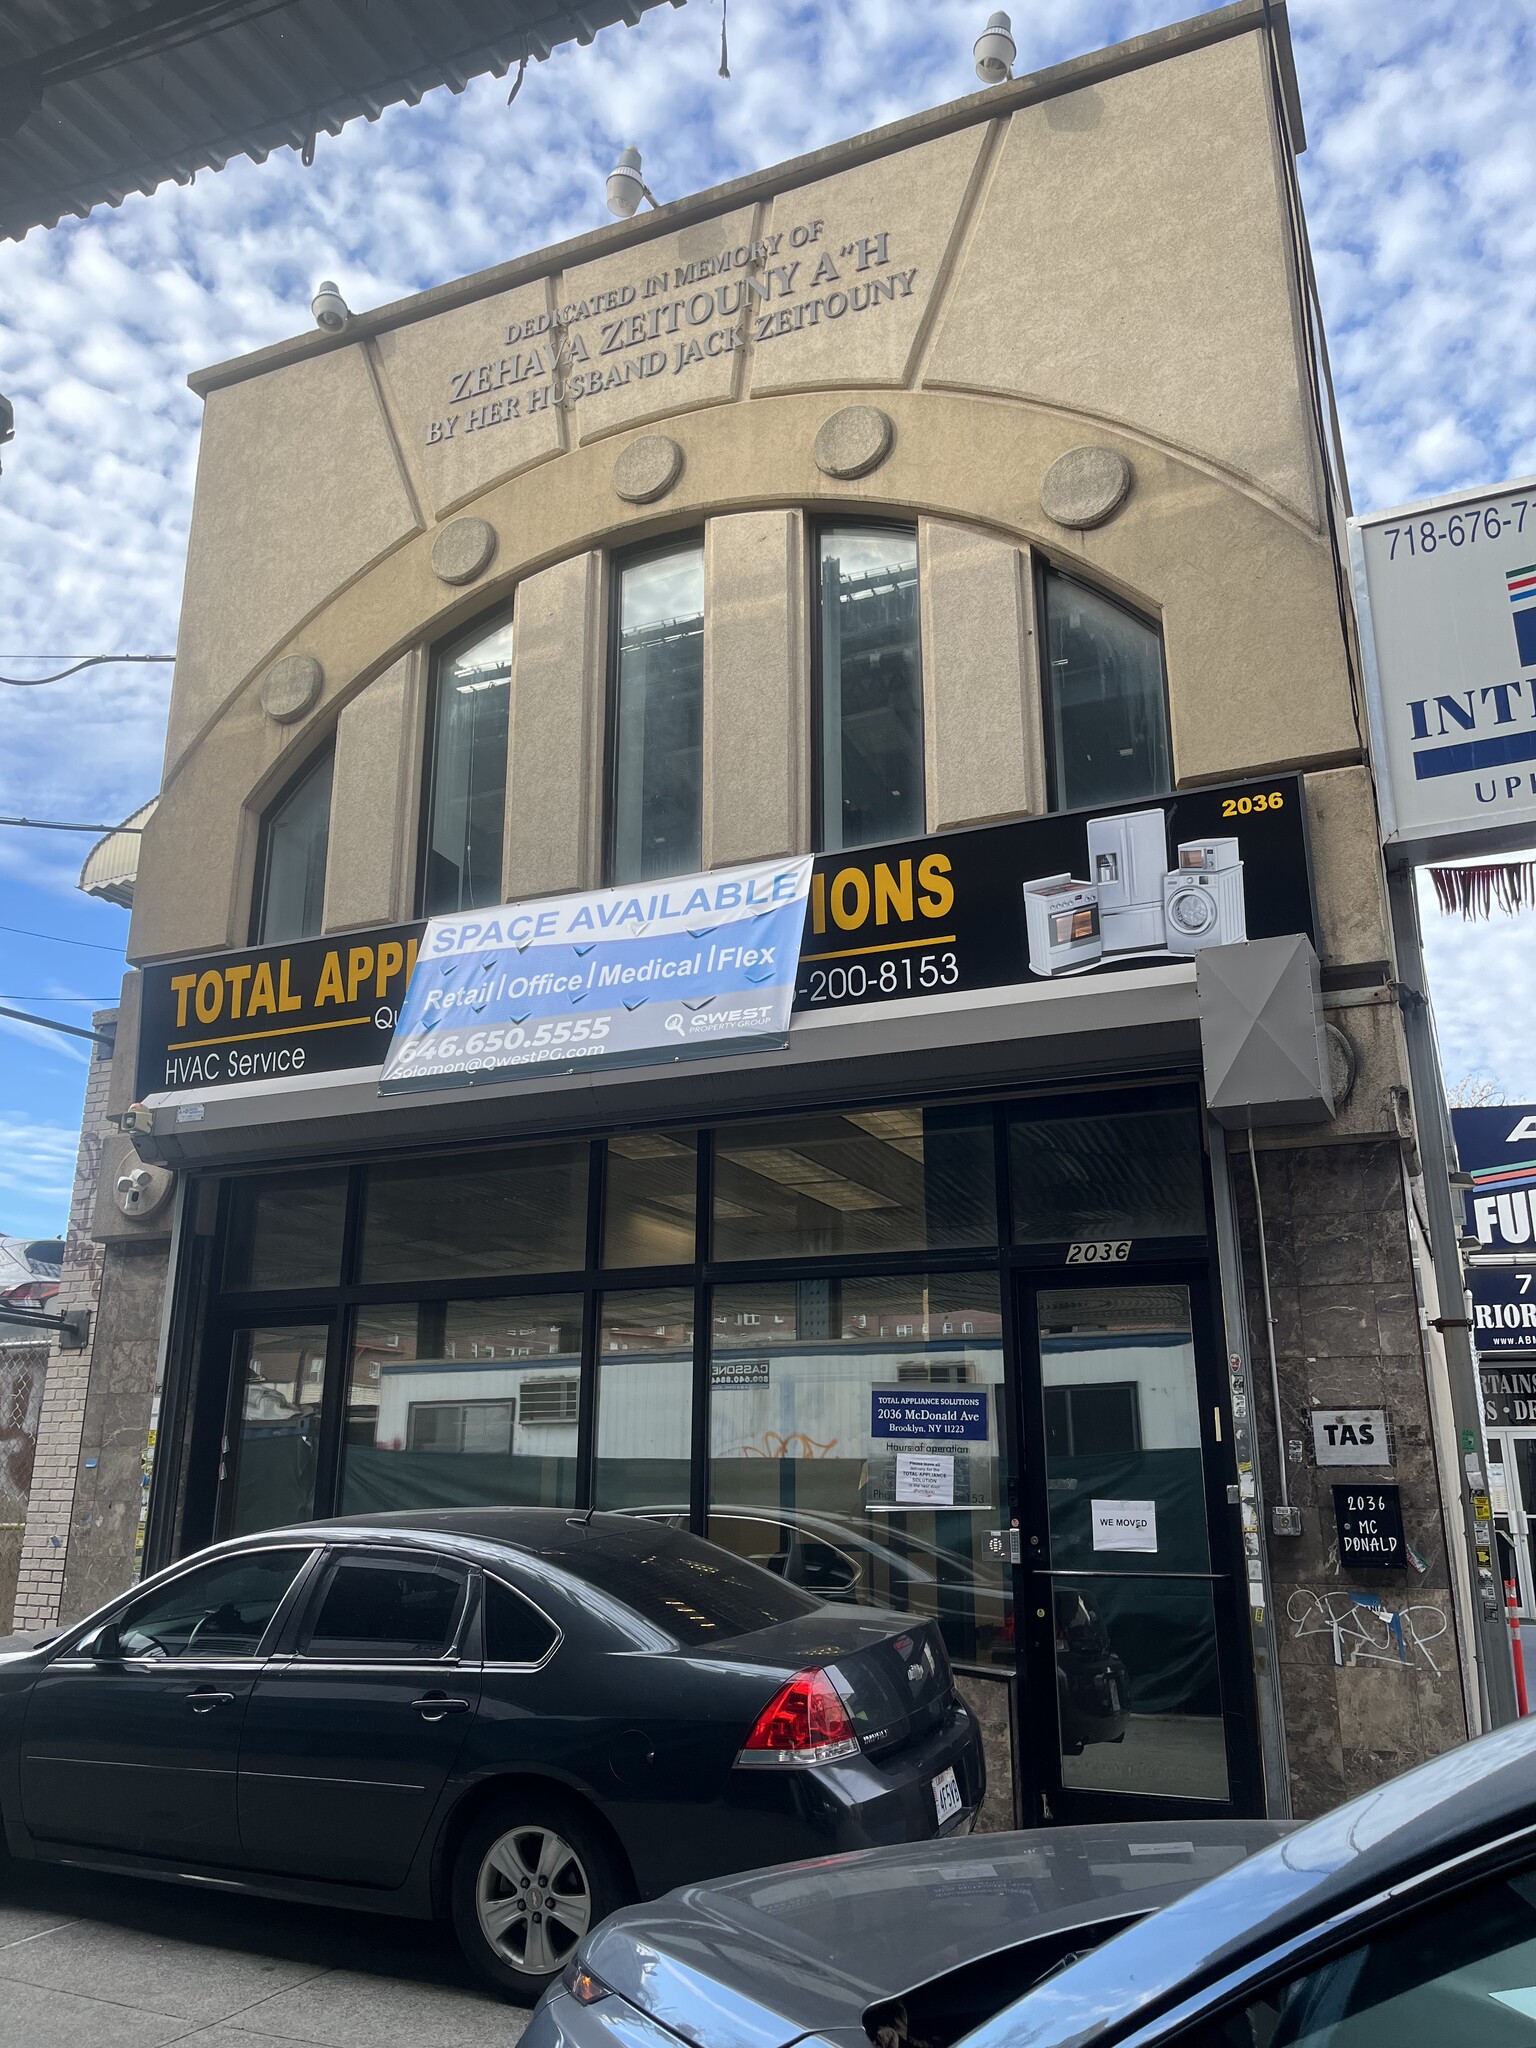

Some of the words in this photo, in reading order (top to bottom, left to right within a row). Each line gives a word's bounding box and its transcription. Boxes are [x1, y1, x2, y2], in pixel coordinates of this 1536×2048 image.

[504, 285, 635, 346] DEDICATED
[641, 272, 669, 299] IN
[673, 232, 784, 289] MEMORY
[788, 219, 825, 248] OF
[449, 333, 590, 404] ZEHAVA
[599, 261, 802, 356] ZEITOUNY
[426, 414, 459, 446] BY
[464, 397, 521, 434] HER
[526, 350, 668, 414] HUSBAND
[672, 323, 746, 375] JACK
[754, 267, 919, 342] ZEITOUNY
[1384, 500, 1536, 561] 718-676-7
[1221, 791, 1284, 818] 2036
[432, 910, 560, 954] SPACE
[566, 871, 799, 933] AVAILABLE
[423, 979, 495, 1011] Retail
[508, 971, 582, 1000] Office
[598, 952, 702, 988] Medical
[717, 945, 776, 972] Flex
[170, 958, 302, 1027] TOTAL
[689, 1021, 736, 1034] PROPERTY
[737, 1017, 771, 1028] GROUP
[690, 1005, 773, 1026] QWEST
[398, 1016, 612, 1064] 646.650.5555
[165, 1052, 220, 1085] HVAC
[227, 1047, 306, 1078] Service
[392, 1044, 606, 1080] Solomon@QwestPG.com
[1474, 1189, 1536, 1244] FU
[1068, 1243, 1129, 1262] 2036
[1515, 1274, 1532, 1294] 7
[878, 1397, 900, 1405] TOTAL
[900, 1397, 939, 1405] APPLIANCE
[940, 1398, 979, 1406] SOLUTIONS
[877, 1408, 901, 1419] 2036
[905, 1409, 957, 1421] McDonald
[960, 1410, 979, 1421] Ave
[928, 1424, 941, 1433] NY
[944, 1425, 964, 1433] 11223
[1323, 1424, 1375, 1446] TAS
[886, 1442, 911, 1452] Hours
[914, 1442, 923, 1452] of
[926, 1443, 969, 1454] operation
[1347, 1495, 1386, 1511] 2036
[1100, 1518, 1114, 1526] WE
[1116, 1519, 1148, 1528] MOVED
[1358, 1519, 1378, 1534] MC
[1343, 1537, 1398, 1552] DONALD
